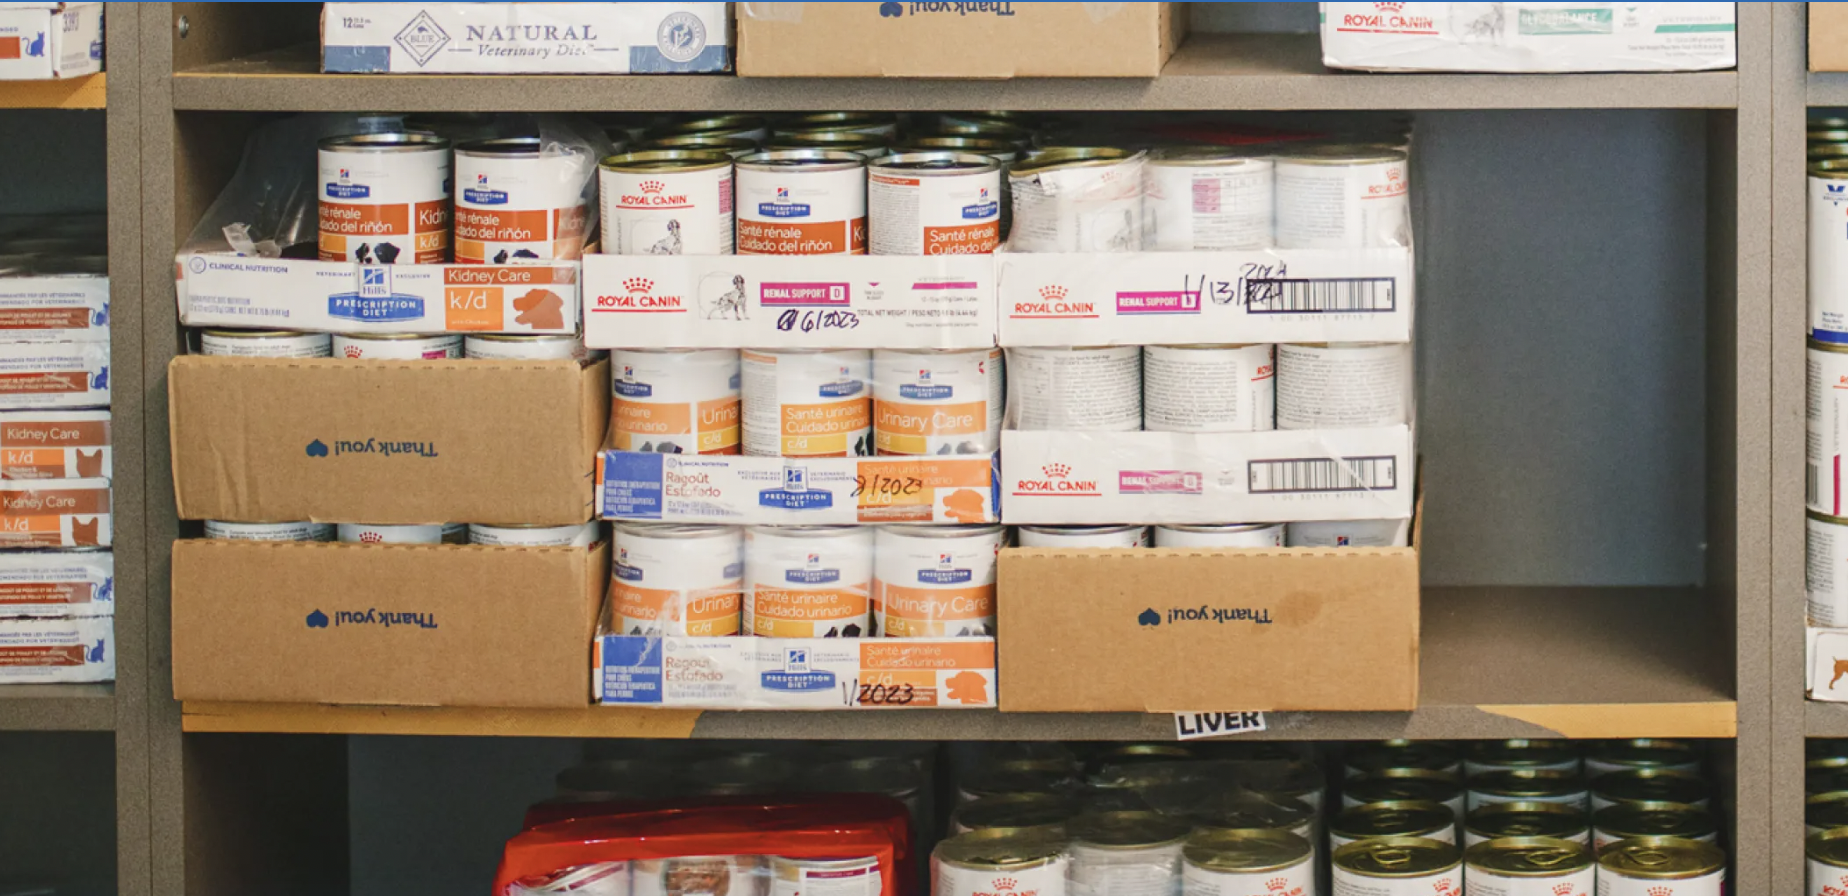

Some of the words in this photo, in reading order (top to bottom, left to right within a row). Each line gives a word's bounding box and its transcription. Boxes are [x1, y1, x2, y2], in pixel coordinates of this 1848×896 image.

[909, 2, 951, 16] you!
[954, 2, 1015, 16] Thank
[343, 17, 353, 29] 12
[1344, 14, 1386, 28] ROYAL
[1389, 16, 1433, 29] CANIN
[410, 34, 435, 44] BLUE
[466, 24, 598, 41] NATURAL
[478, 43, 551, 59] Veterinary
[620, 194, 650, 205] ROYAL
[652, 194, 688, 205] CANIN
[329, 206, 362, 220] rénale
[419, 209, 448, 226] Kidn
[467, 213, 500, 226] rénale
[320, 220, 340, 232] dado
[340, 220, 358, 233] del
[359, 220, 394, 234] riñón
[478, 227, 496, 239] del
[497, 227, 531, 240] riñón
[739, 222, 763, 237] Santé
[763, 225, 803, 239] rénale
[419, 235, 440, 248] k/d
[929, 228, 966, 243] Santé
[739, 236, 776, 252] Cuidado
[777, 239, 798, 252] del
[799, 239, 833, 252] riñón
[929, 242, 980, 255] Cuidado
[208, 262, 244, 271] CLINICAL
[245, 263, 289, 274] NUTRITION
[448, 269, 496, 285] Kidney
[497, 268, 531, 282] Care
[450, 290, 487, 310] k/d
[763, 288, 790, 299] RENAL
[791, 288, 826, 299] SUPPORT
[833, 287, 841, 299] D
[335, 299, 417, 309] PRESCRIPTION
[597, 295, 637, 307] ROYAL
[639, 295, 681, 307] CANIN
[1015, 302, 1052, 313] ROYAL
[1054, 302, 1093, 313] CANIN
[1119, 297, 1145, 307] RENAL
[1145, 297, 1178, 307] SUPPORT
[362, 309, 388, 317] DIET
[702, 406, 739, 425] Urina
[785, 407, 824, 420] Santé
[825, 404, 863, 419] urinaire
[878, 406, 928, 433] Urinary
[932, 410, 973, 429] Care
[785, 421, 839, 433] Cuidado
[7, 428, 48, 443] Kidney
[49, 427, 80, 440] Care
[703, 431, 722, 445] c/d
[334, 437, 376, 457] you!
[378, 440, 439, 458] Thank
[787, 437, 808, 449] c/d
[8, 450, 34, 464] k/d
[864, 464, 896, 475] Santé
[898, 464, 939, 475] urinaire
[665, 471, 709, 485] Ragoût
[665, 485, 721, 498] Estofado
[1018, 480, 1055, 491] ROYAL
[1057, 480, 1097, 491] CANIN
[3, 495, 43, 510] Kidney
[45, 495, 76, 508] Care
[764, 493, 827, 501] PRESCRIPTION
[3, 517, 29, 532] k/d
[757, 591, 789, 603] Santé
[790, 592, 839, 604] urinaire
[757, 601, 804, 617] Cuidado
[806, 603, 853, 617] urinario
[887, 593, 948, 617] Urinary
[951, 595, 989, 613] Care
[334, 607, 376, 627] you!
[378, 611, 438, 629] Thank
[1167, 604, 1208, 624] you!
[1211, 607, 1273, 624] Thank
[692, 621, 712, 633] c/d
[866, 645, 899, 656] Santé
[901, 645, 942, 656] urinaire
[866, 656, 913, 668] Cuidado
[913, 657, 956, 668] urinario
[766, 674, 830, 682] PRESCRIPTION
[866, 671, 893, 685] c/d
[1178, 711, 1260, 735] LIVER
